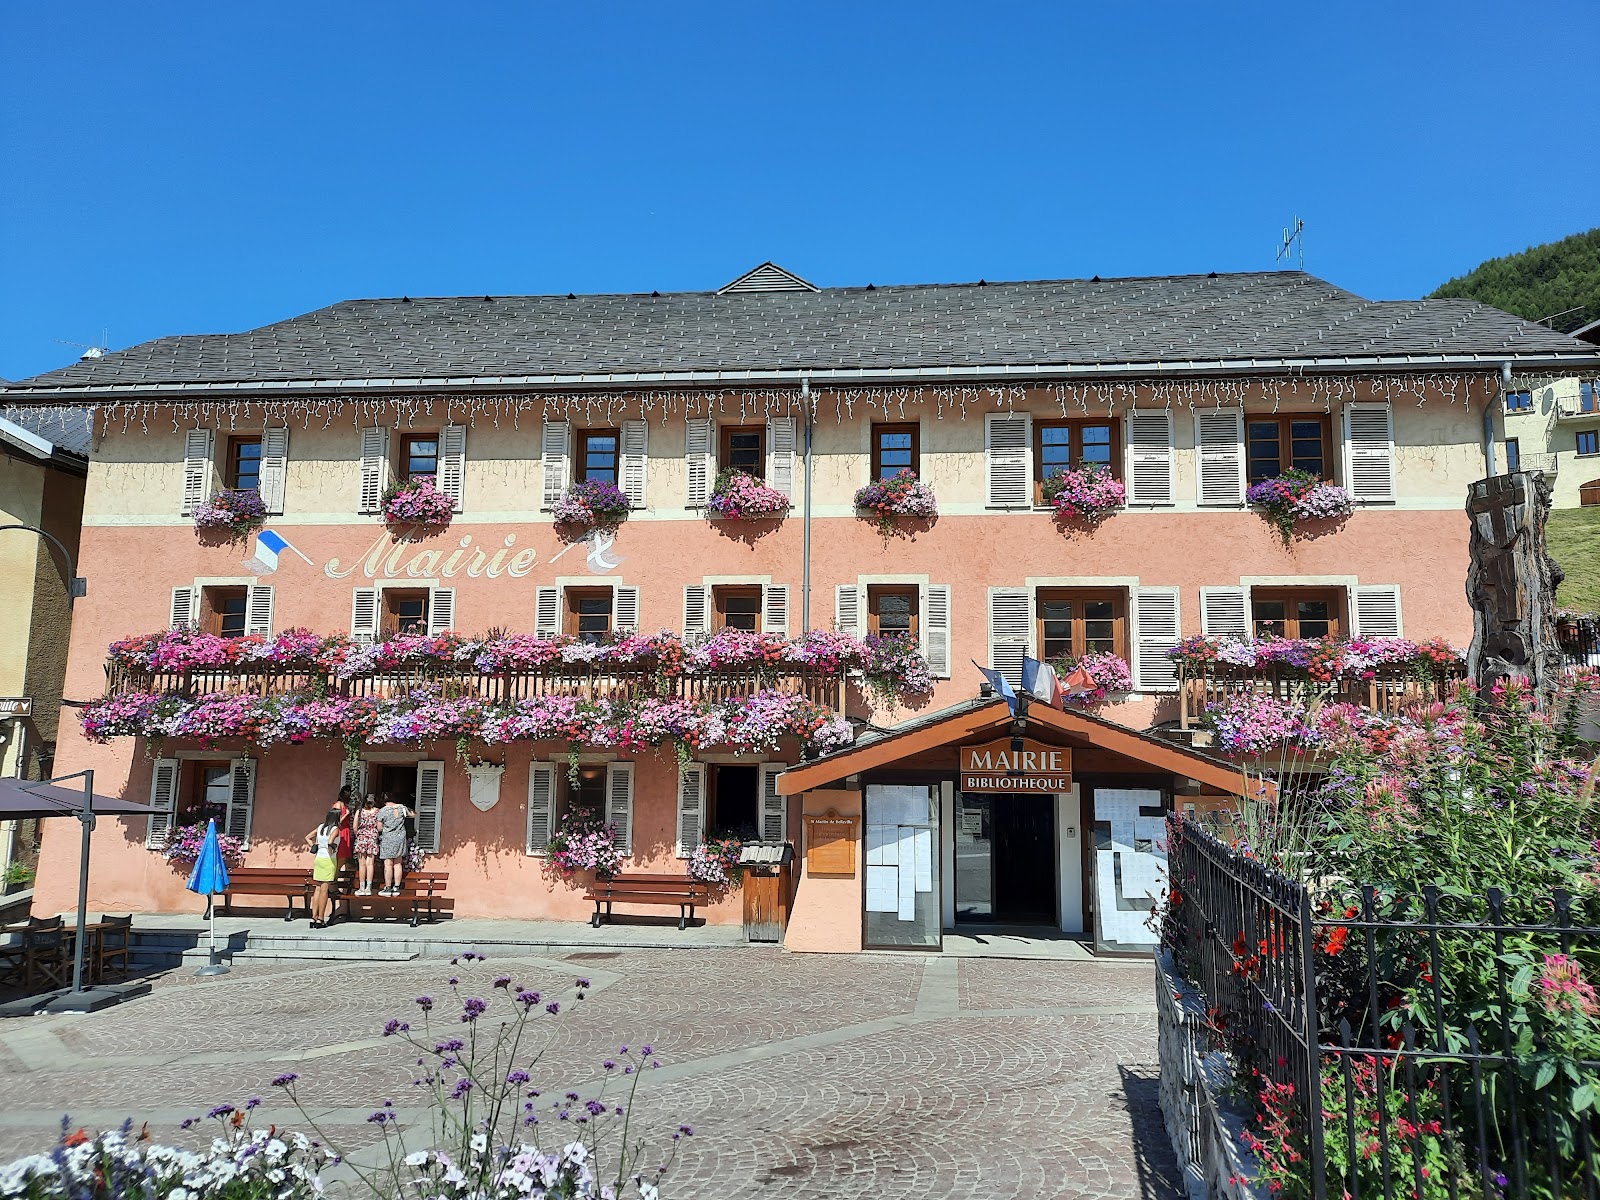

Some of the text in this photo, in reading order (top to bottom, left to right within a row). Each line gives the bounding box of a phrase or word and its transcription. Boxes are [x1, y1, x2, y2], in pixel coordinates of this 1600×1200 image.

[324, 528, 539, 578] Mairie
[970, 750, 1063, 771] MAIRIE
[967, 777, 1066, 791] BIBLIOTHEQUE
